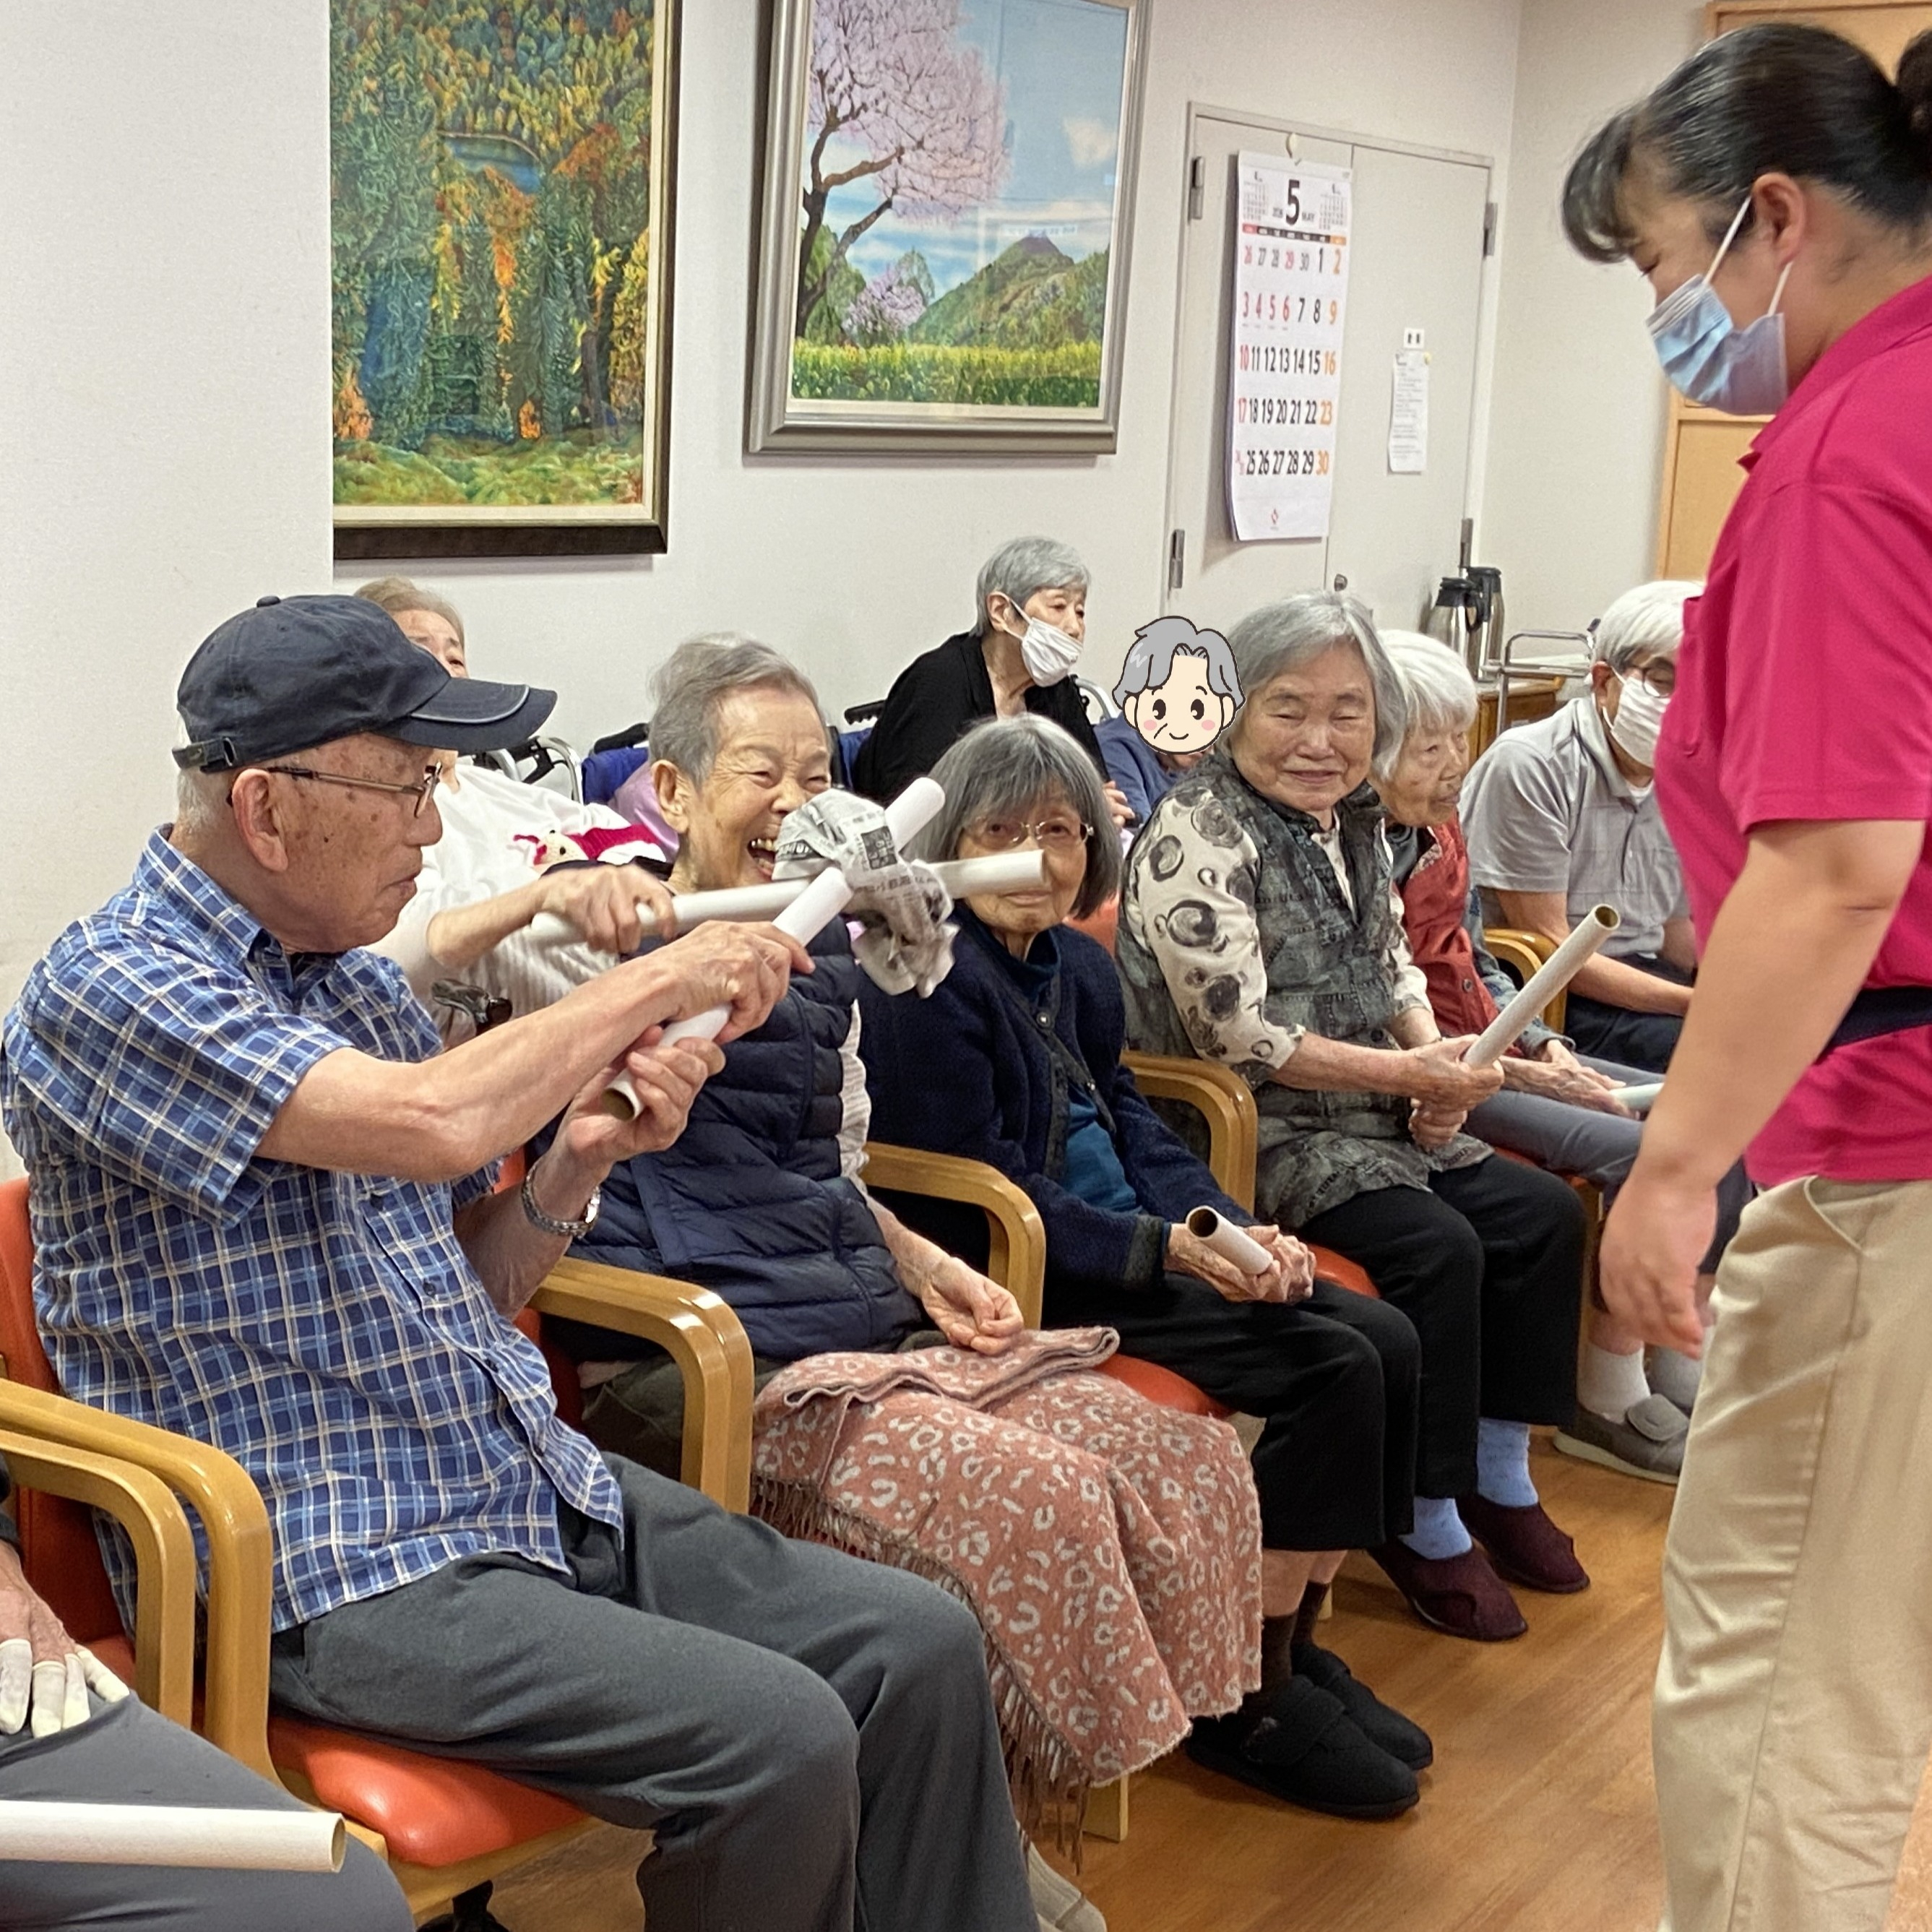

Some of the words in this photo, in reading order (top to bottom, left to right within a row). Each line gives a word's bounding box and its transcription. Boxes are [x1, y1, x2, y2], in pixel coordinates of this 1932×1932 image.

[1285, 179, 1300, 225] 5
[1319, 248, 1324, 273] 1
[1333, 249, 1341, 275] 2
[1243, 291, 1249, 318] 3
[1256, 293, 1262, 319] 4
[1269, 294, 1275, 320] 5
[1282, 296, 1290, 322] 6
[1298, 298, 1306, 322] 7
[1314, 298, 1321, 324] 8
[1329, 300, 1337, 325] 9
[1240, 345, 1249, 371] 10
[1251, 346, 1260, 371] 11
[1265, 347, 1276, 372] 12
[1280, 348, 1290, 374] 13
[1294, 348, 1305, 374] 14
[1308, 350, 1321, 375] 15
[1324, 350, 1336, 376] 16
[1238, 397, 1247, 423] 17
[1249, 398, 1259, 423] 18
[1262, 398, 1274, 424] 19
[1276, 399, 1288, 424] 20
[1290, 400, 1301, 424] 21
[1305, 400, 1317, 424] 22
[1320, 400, 1332, 426] 23
[1246, 449, 1256, 475] 25
[1258, 449, 1269, 475] 26
[1272, 449, 1285, 475] 27
[1286, 449, 1299, 475] 28
[1301, 450, 1314, 475] 29
[1316, 450, 1329, 475] 30
